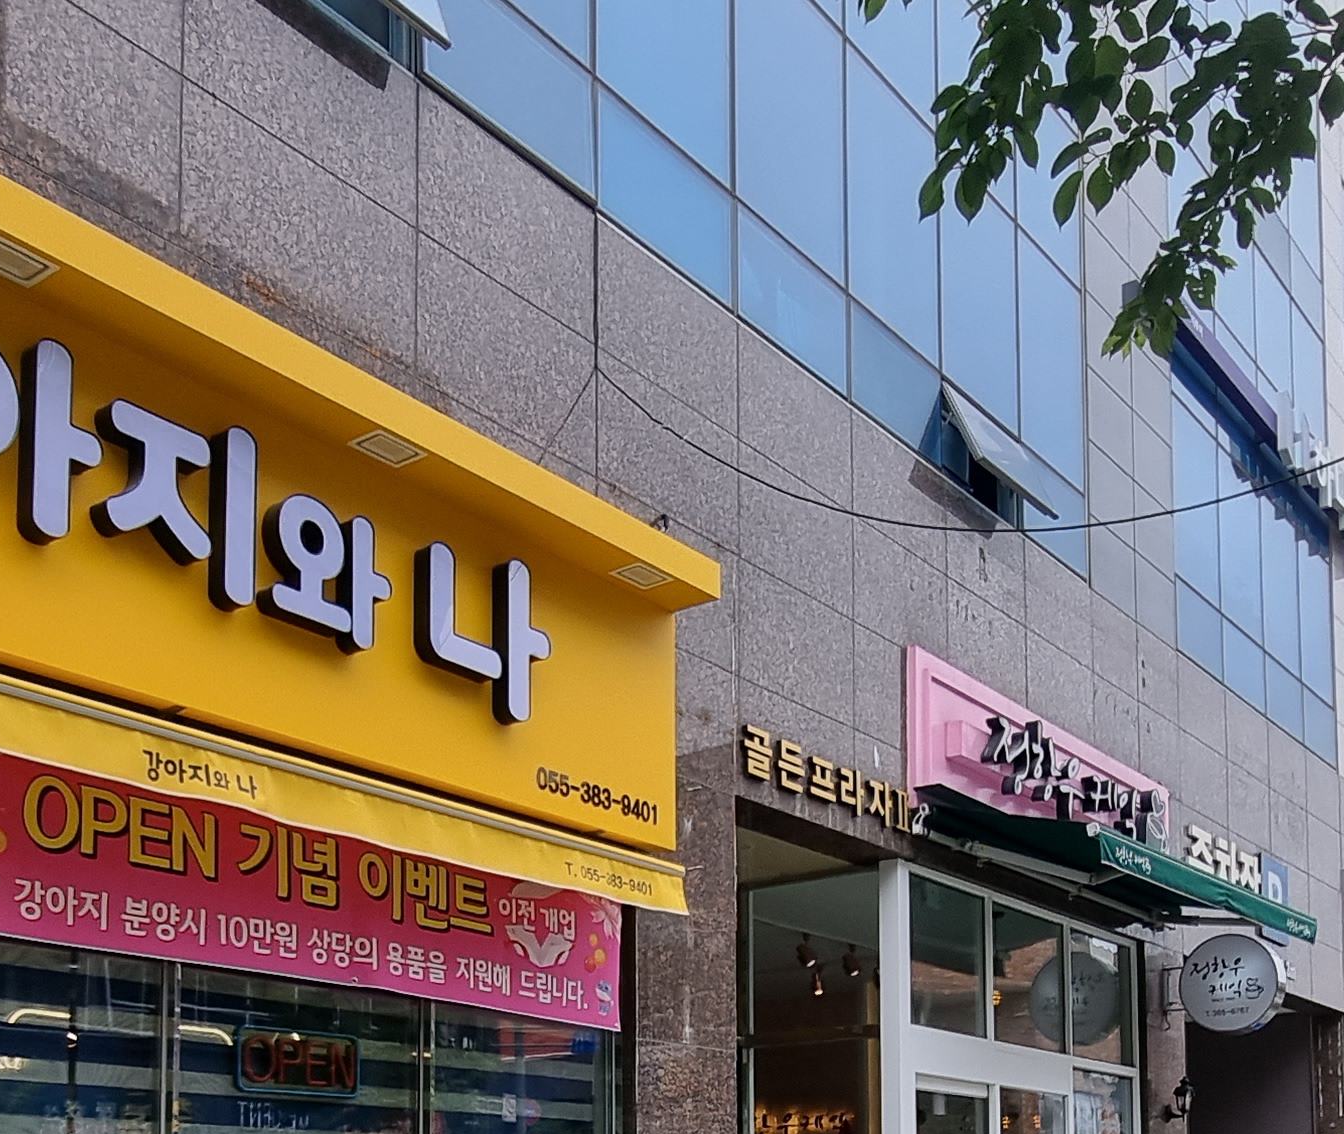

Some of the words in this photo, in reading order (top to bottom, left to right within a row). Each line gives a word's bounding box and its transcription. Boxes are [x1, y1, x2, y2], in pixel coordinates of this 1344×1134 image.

[413, 540, 552, 726] 나
[142, 748, 231, 792] 강아지와
[235, 773, 258, 801] 나
[535, 766, 659, 828] 055-383-9401
[22, 773, 220, 882] OPEN
[237, 821, 342, 909] 기념
[356, 850, 497, 938] 이벤트
[13, 876, 111, 932] 강아지
[120, 896, 209, 947] 분양시
[215, 911, 300, 962] 10만원
[306, 926, 383, 974] 상당의
[384, 944, 450, 982] 용품을
[454, 953, 512, 999] 지원해
[517, 966, 590, 1011] 드립니다.
[497, 895, 537, 936] 이전
[539, 902, 579, 942] 개업
[1189, 955, 1245, 981] 정항우
[242, 1034, 358, 1090] OPEN
